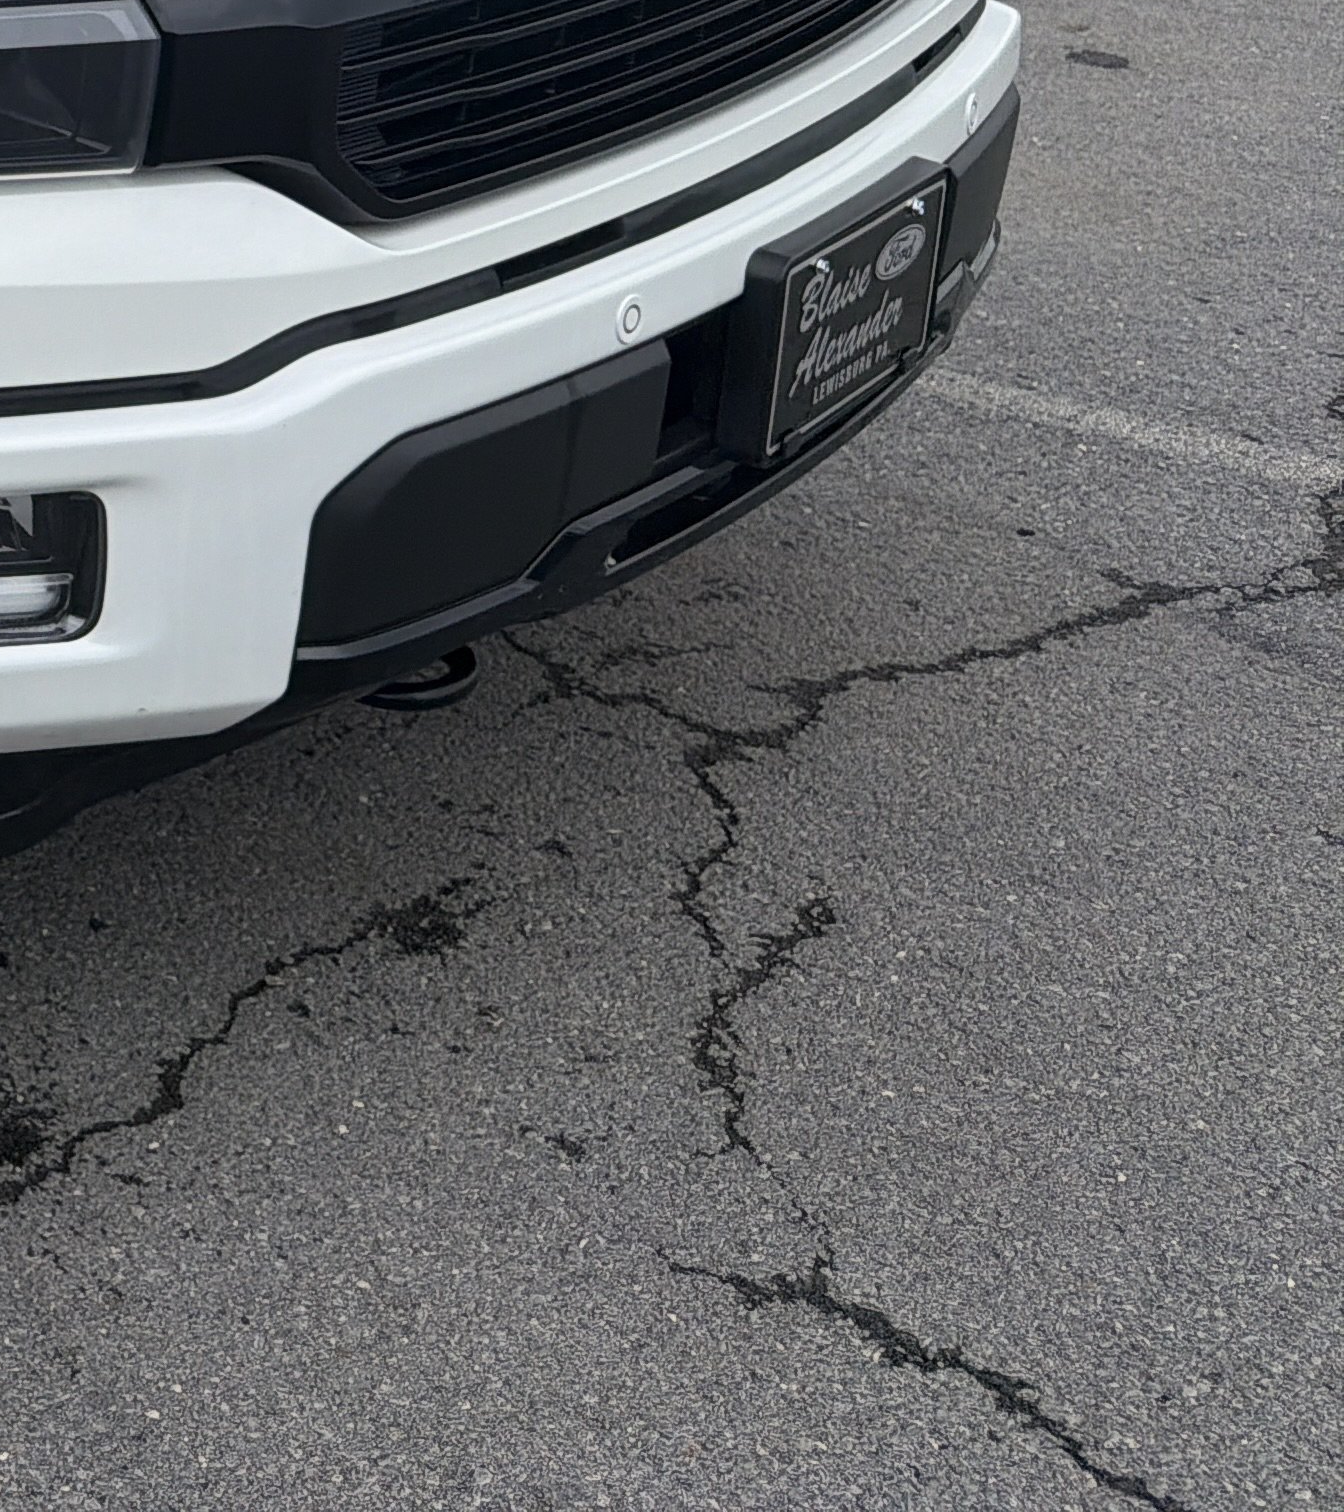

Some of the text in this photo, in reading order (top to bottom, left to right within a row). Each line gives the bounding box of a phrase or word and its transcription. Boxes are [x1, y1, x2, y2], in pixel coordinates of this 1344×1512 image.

[884, 233, 917, 274] Ford
[799, 263, 872, 334] Blaise
[788, 289, 903, 398] Alexander
[812, 350, 873, 405] LEWISBURG
